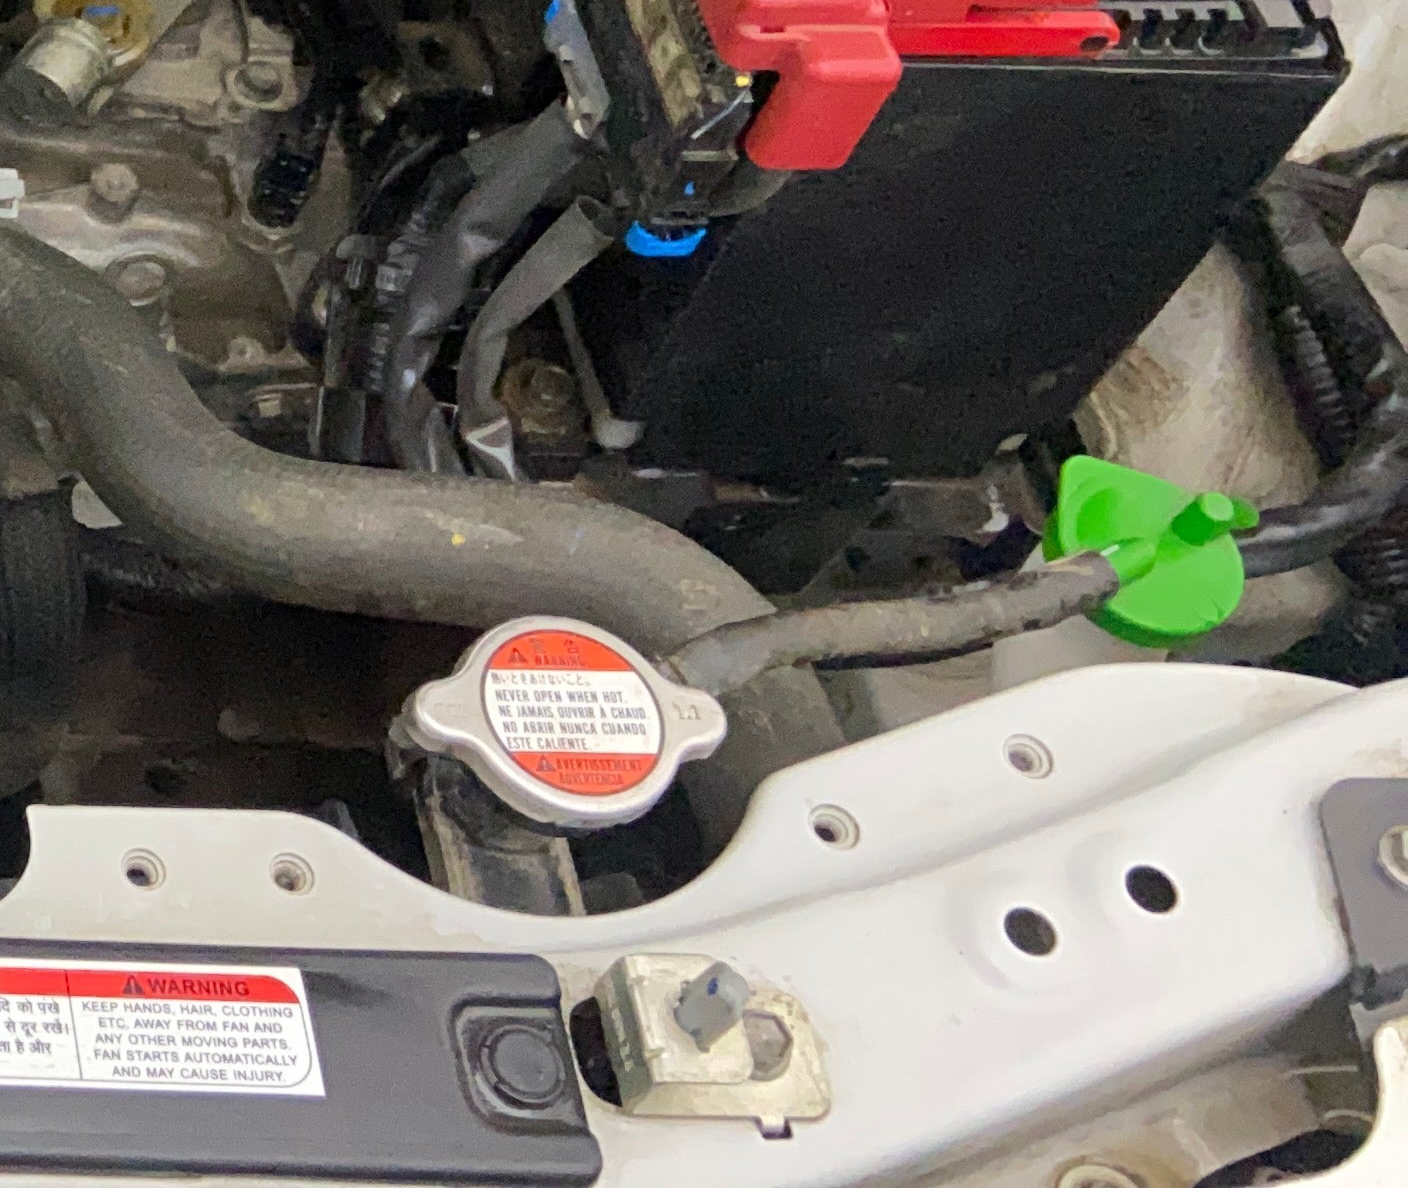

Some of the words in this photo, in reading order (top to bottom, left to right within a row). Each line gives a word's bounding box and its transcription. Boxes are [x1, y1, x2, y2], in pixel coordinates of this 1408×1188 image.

[495, 690, 529, 702] NEVER
[535, 690, 562, 703] OPEN
[566, 691, 597, 703] WHEN
[603, 692, 627, 704] HOT.
[499, 706, 512, 717] NE
[517, 706, 554, 718] JAMAIS
[558, 706, 594, 719] OUVRIR
[503, 722, 517, 733] NO
[523, 722, 554, 734] ABRIR
[560, 723, 597, 735] NUNCA
[602, 723, 646, 736] CUANDO
[507, 737, 535, 749] ESTE
[147, 978, 250, 996] WARNING
[18, 997, 33, 1014] को
[82, 1002, 118, 1012] KEEP
[124, 1003, 175, 1016] HANDS,
[180, 1006, 217, 1017] HAIR,
[222, 1006, 293, 1018] CLOTHING
[4, 1018, 16, 1032] से
[21, 1021, 37, 1037] दूर
[134, 1019, 171, 1030] AWAY
[177, 1020, 217, 1031] FROM
[223, 1021, 250, 1032] FAN
[254, 1022, 282, 1033] AND
[16, 1039, 25, 1054] है
[29, 1040, 52, 1055] और
[95, 1034, 122, 1045] ANY
[128, 1035, 176, 1046] OTHER
[181, 1036, 237, 1048] MOVING
[243, 1038, 292, 1050] PARTS.
[94, 1049, 121, 1061] FAN
[126, 1051, 179, 1062] STARTS
[184, 1051, 297, 1066] AUTOMATICALLY
[112, 1067, 140, 1078] AND
[146, 1067, 175, 1078] MAY
[180, 1068, 228, 1080] CAUSE
[234, 1070, 286, 1083] INJURY.
